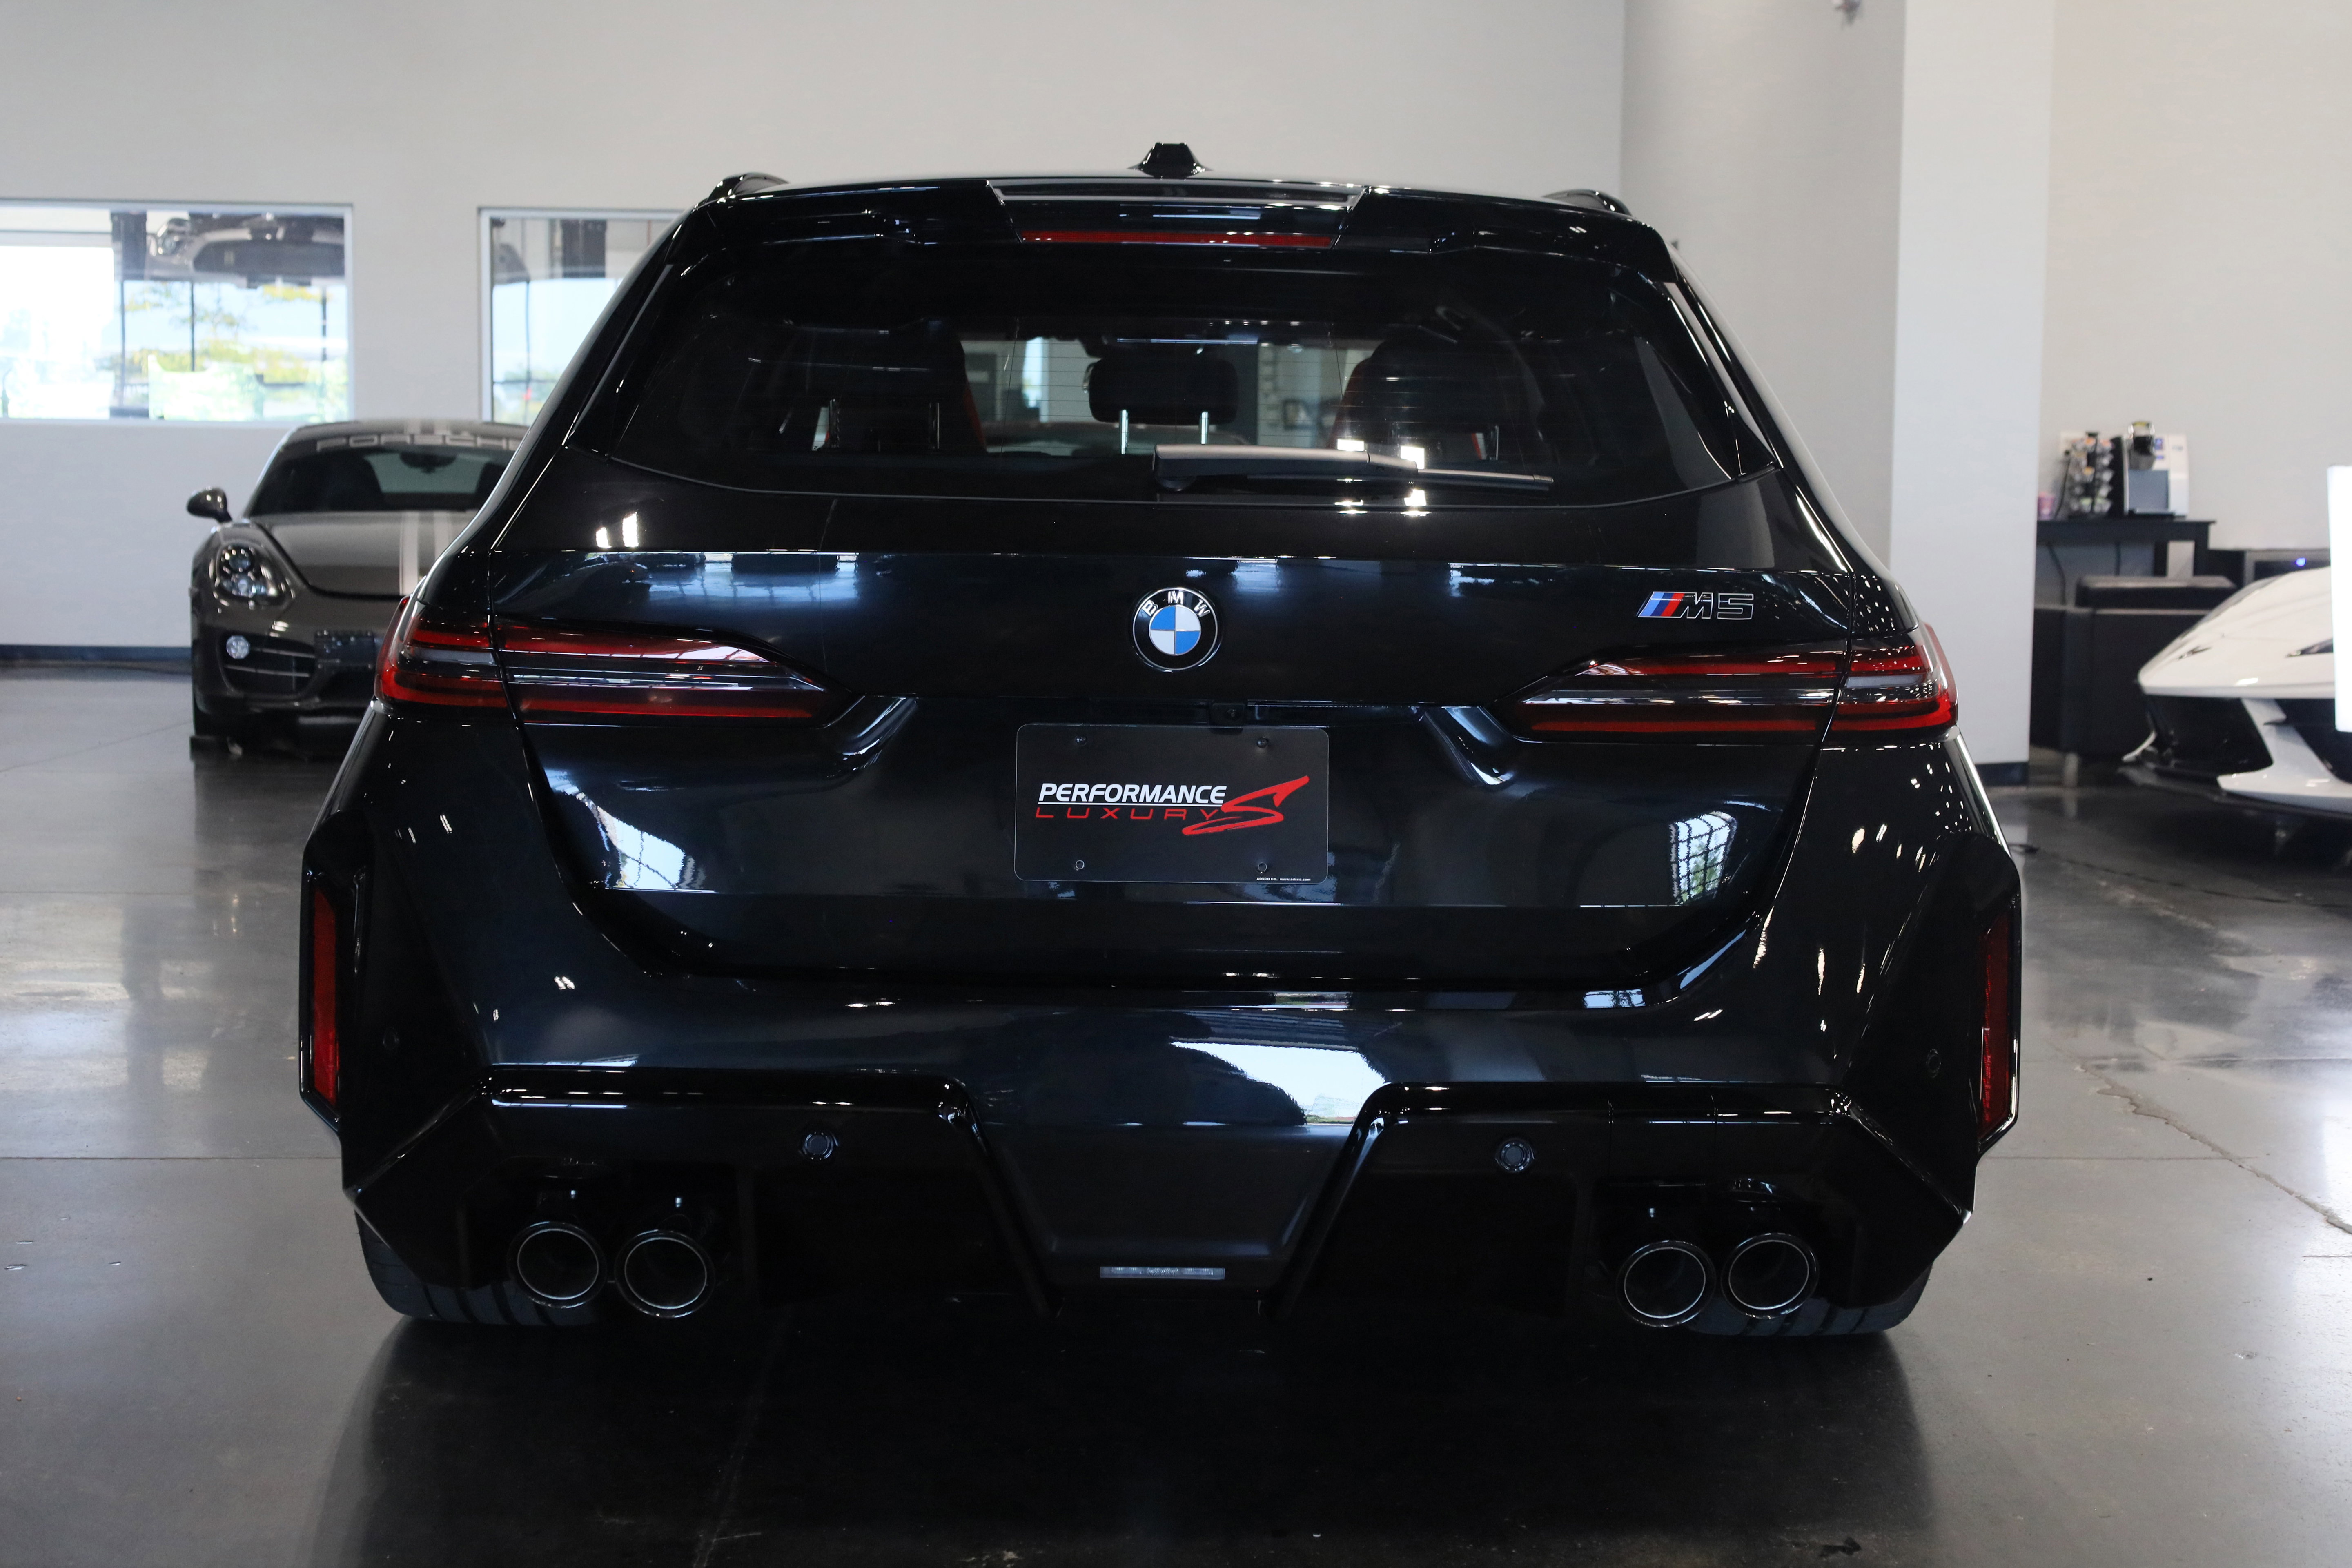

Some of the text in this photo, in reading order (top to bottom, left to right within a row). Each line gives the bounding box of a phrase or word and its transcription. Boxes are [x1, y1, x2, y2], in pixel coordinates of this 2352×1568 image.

[1141, 590, 1211, 617] BMW
[1637, 591, 1754, 620] M5
[1038, 783, 1227, 803] PERFORMANCE
[1035, 807, 1218, 820] LUXURY
